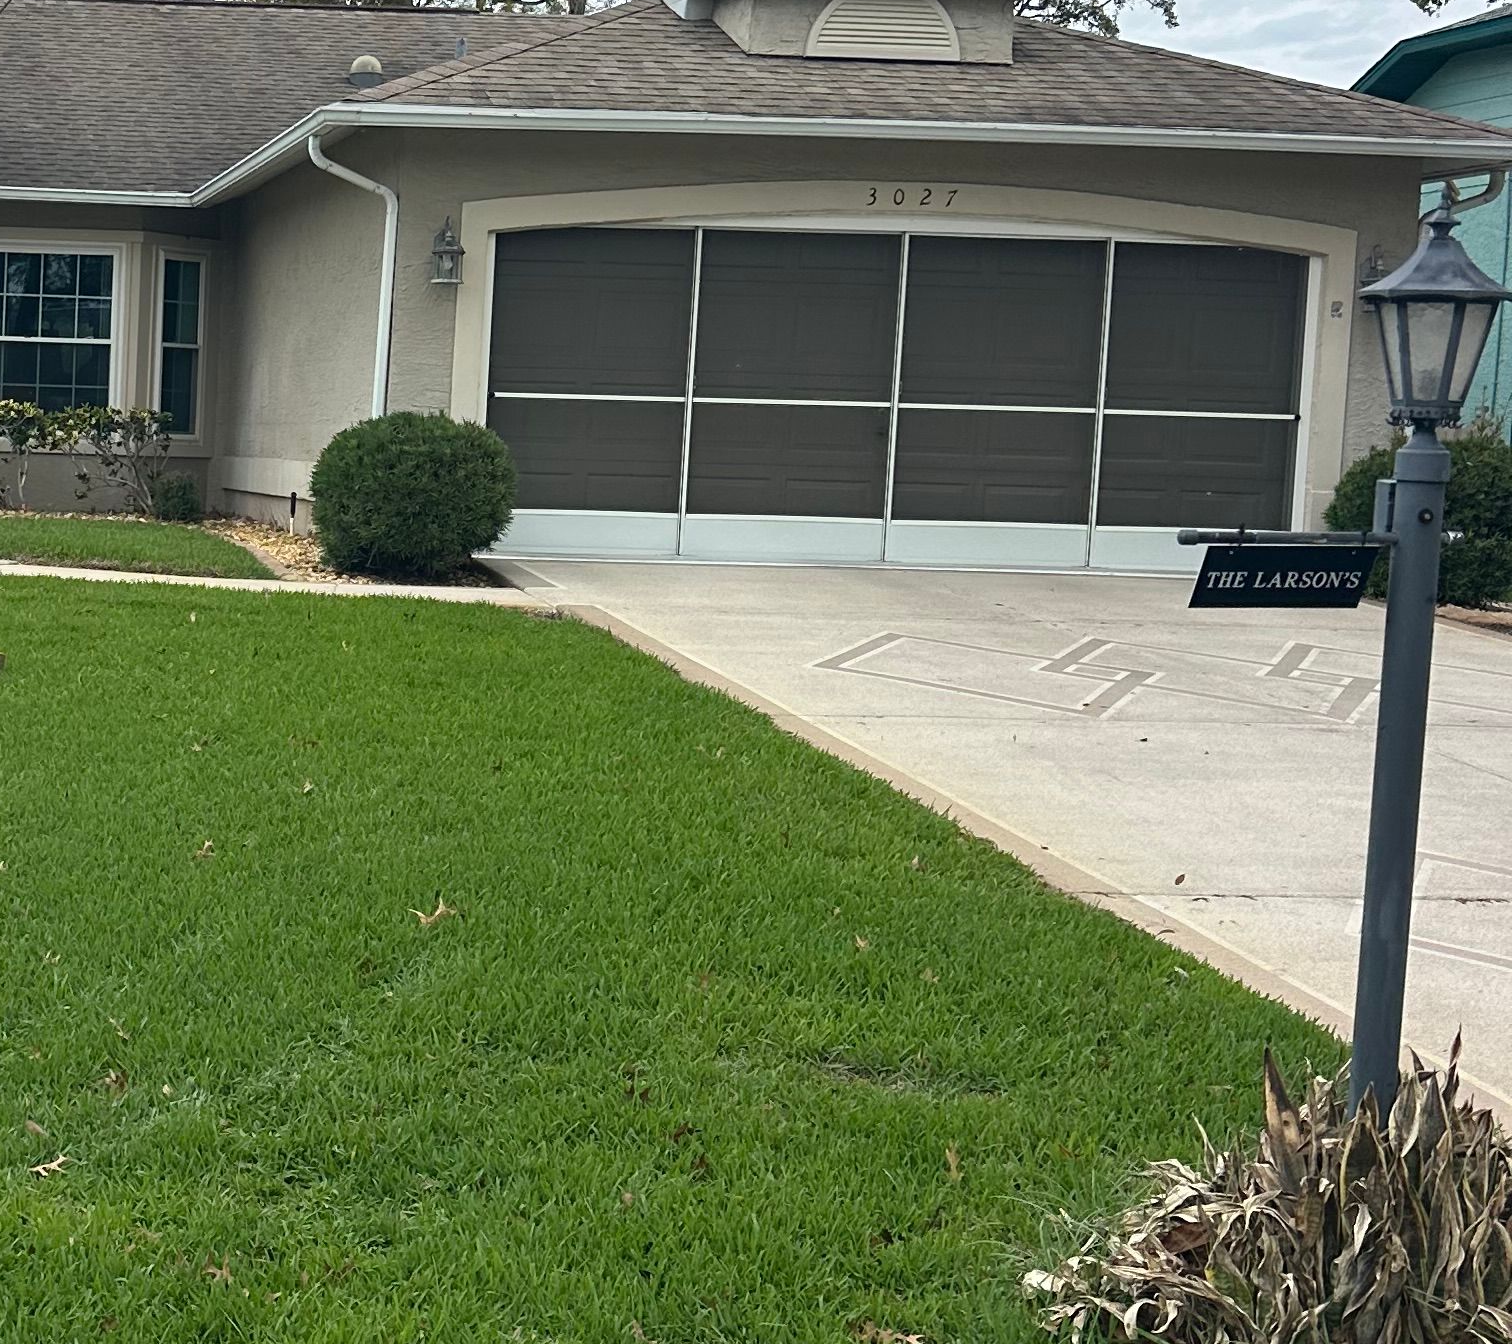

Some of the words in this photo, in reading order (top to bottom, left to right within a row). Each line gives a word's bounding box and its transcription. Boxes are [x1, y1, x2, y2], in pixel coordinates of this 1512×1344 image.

[866, 187, 958, 207] 3027
[1207, 571, 1248, 589] THE
[1253, 571, 1362, 589] LARSON'S
